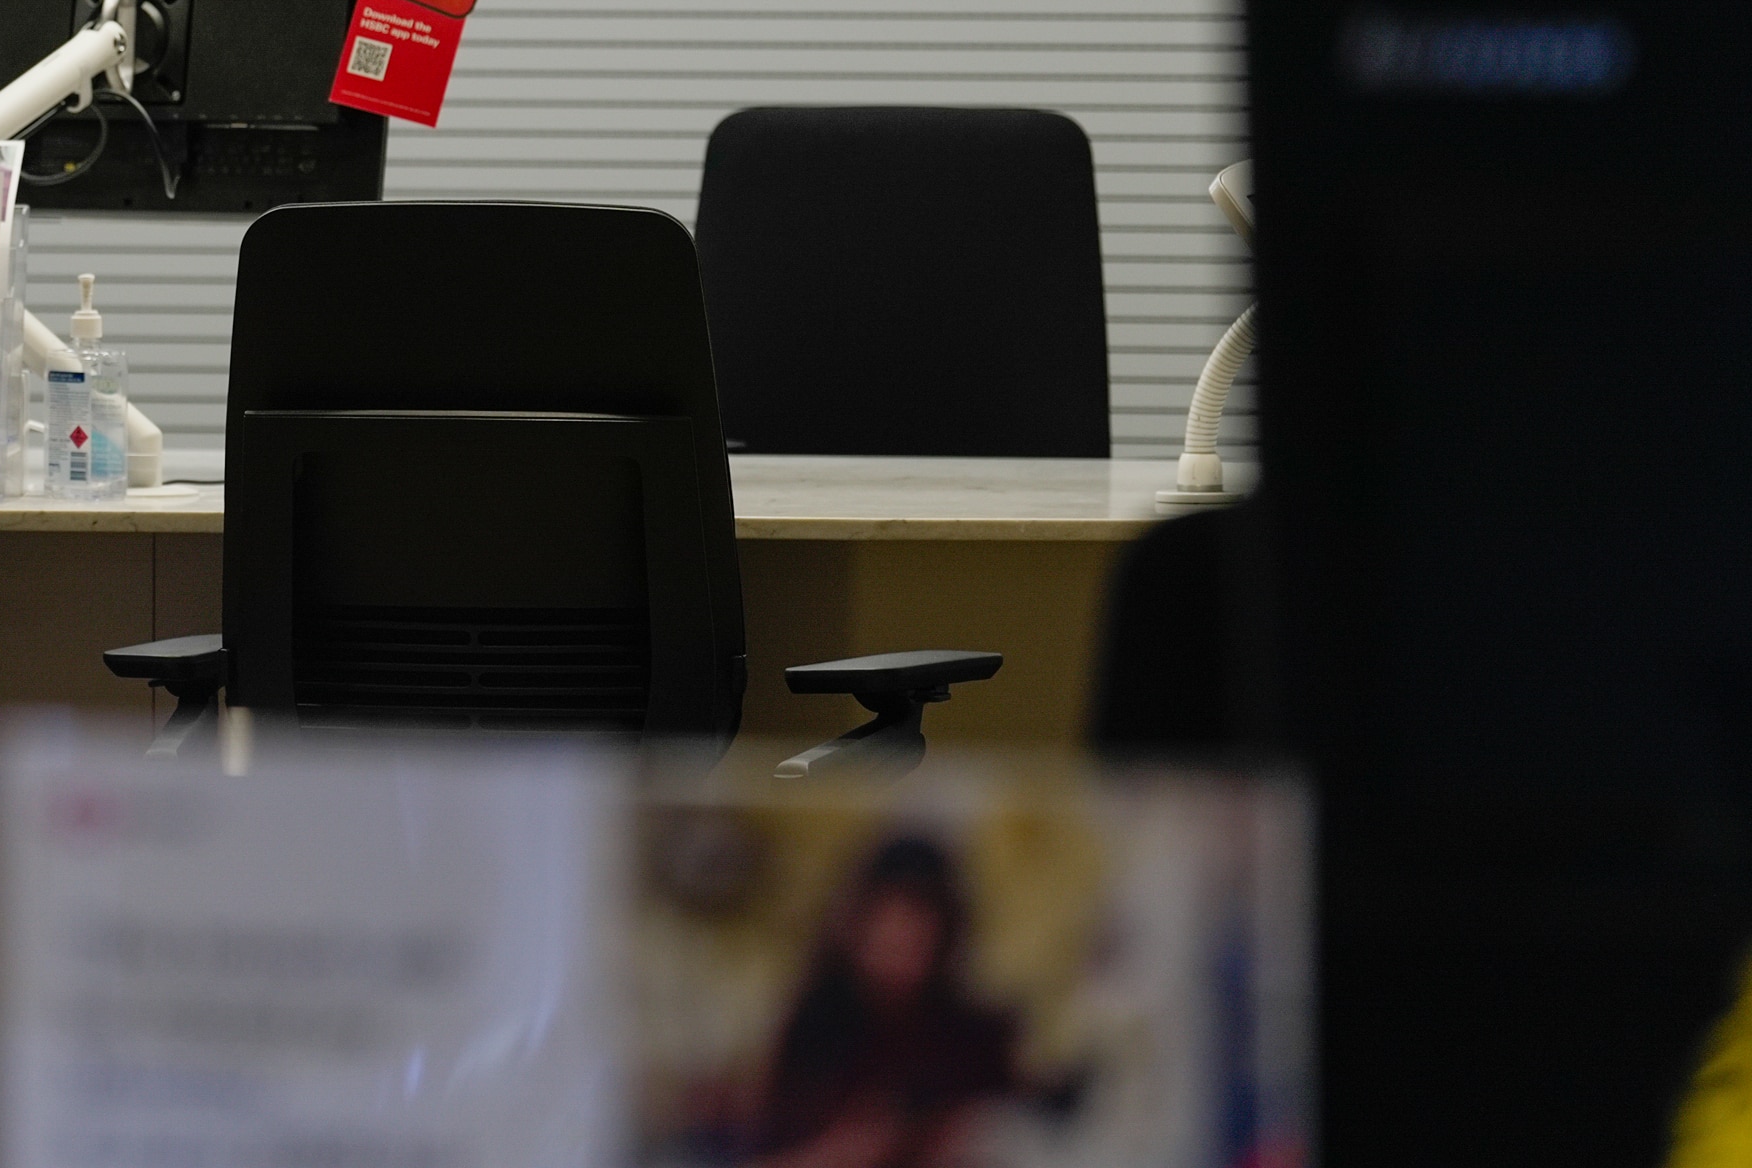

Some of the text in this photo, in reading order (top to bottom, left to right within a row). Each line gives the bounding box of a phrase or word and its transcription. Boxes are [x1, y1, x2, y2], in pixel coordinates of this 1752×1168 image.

[360, 18, 440, 49] HSBC app today
[363, 7, 432, 34] Download the
